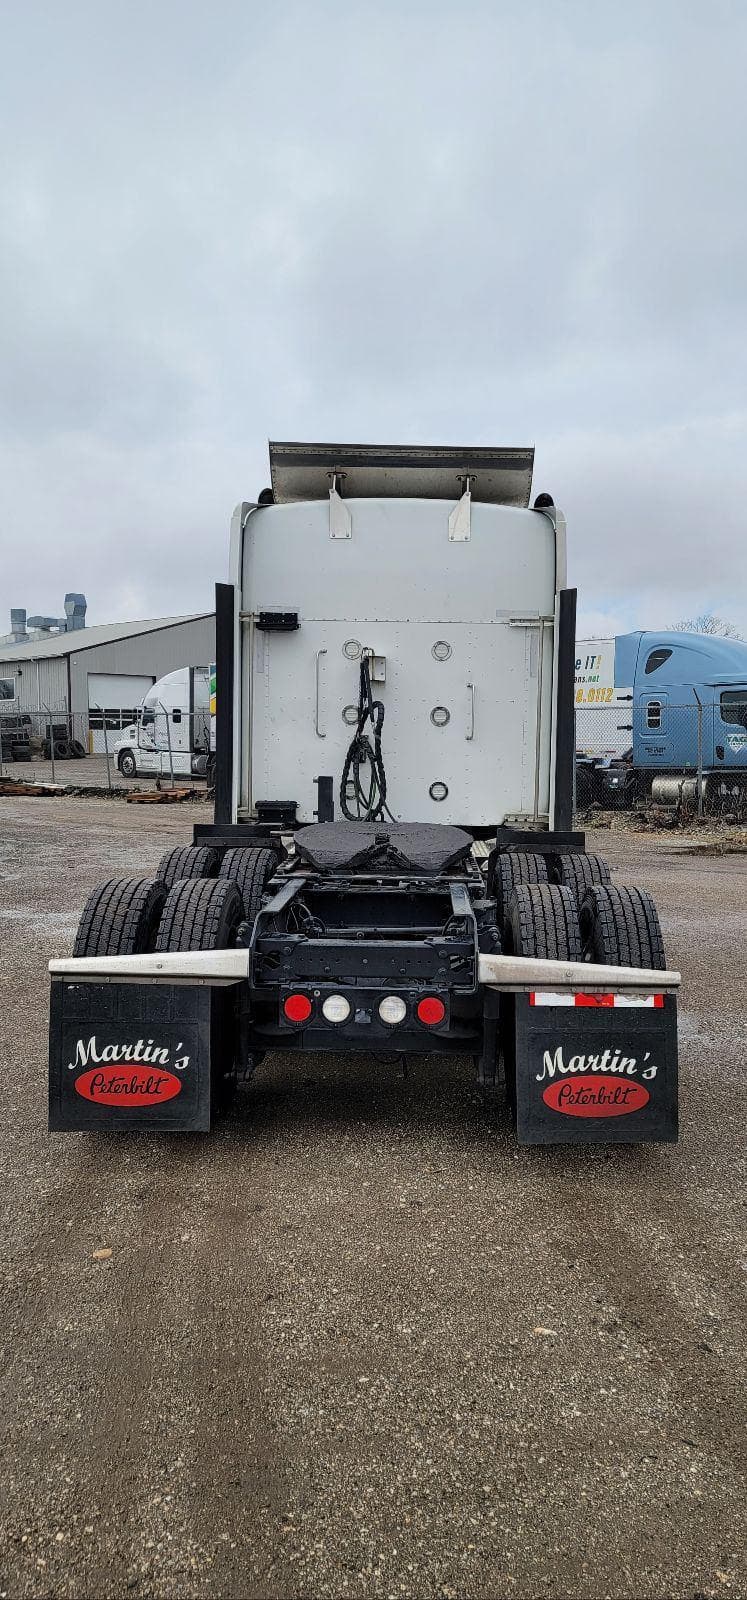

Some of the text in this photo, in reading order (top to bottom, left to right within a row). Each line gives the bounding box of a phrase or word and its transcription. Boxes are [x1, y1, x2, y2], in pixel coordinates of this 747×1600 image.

[585, 654, 602, 670] IT!
[68, 1035, 190, 1070] Martin's
[536, 1046, 658, 1081] Martin's
[90, 1073, 169, 1096] Peterbilt
[557, 1083, 637, 1107] Peterbilt
